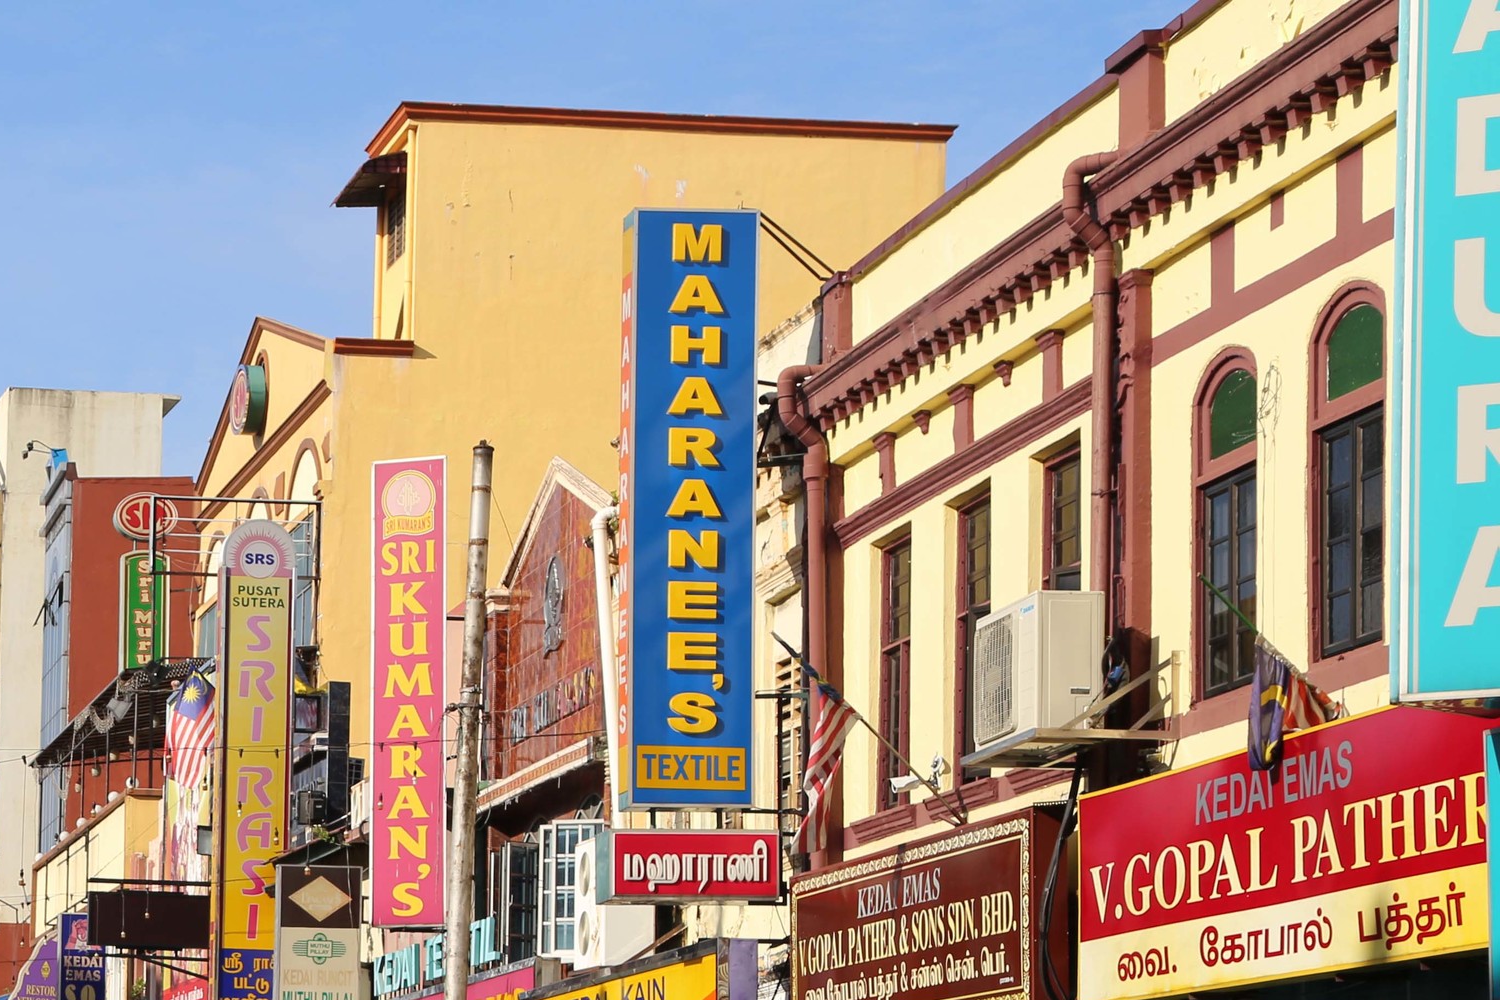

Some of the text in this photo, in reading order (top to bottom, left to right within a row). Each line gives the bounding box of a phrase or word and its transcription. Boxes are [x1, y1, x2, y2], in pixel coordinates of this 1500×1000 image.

[666, 222, 724, 734] MAHARANEE'S
[385, 519, 395, 534] SRI
[244, 553, 275, 565] SRS
[232, 597, 285, 609] SUTERA
[238, 585, 281, 597] PUSAT
[238, 615, 276, 742] SRI
[381, 539, 436, 917] SRI KUMARAN'S
[642, 753, 741, 782] TEXTILE
[1194, 740, 1353, 826] KEDAI EMAS
[1290, 771, 1488, 884] PATHER
[623, 838, 768, 894] மஹாராணி
[902, 867, 942, 909] EMAS
[847, 918, 898, 967] PATHER
[899, 914, 910, 956] &
[911, 905, 945, 954] SONS
[947, 898, 978, 945] SDN.
[981, 890, 1018, 939] BHD.
[63, 955, 103, 968] KEDAI
[65, 970, 101, 981] EMAS
[283, 968, 353, 987] KEDAI RUNCIT
[373, 942, 421, 998] KEDAI
[233, 973, 270, 995] பட்டு
